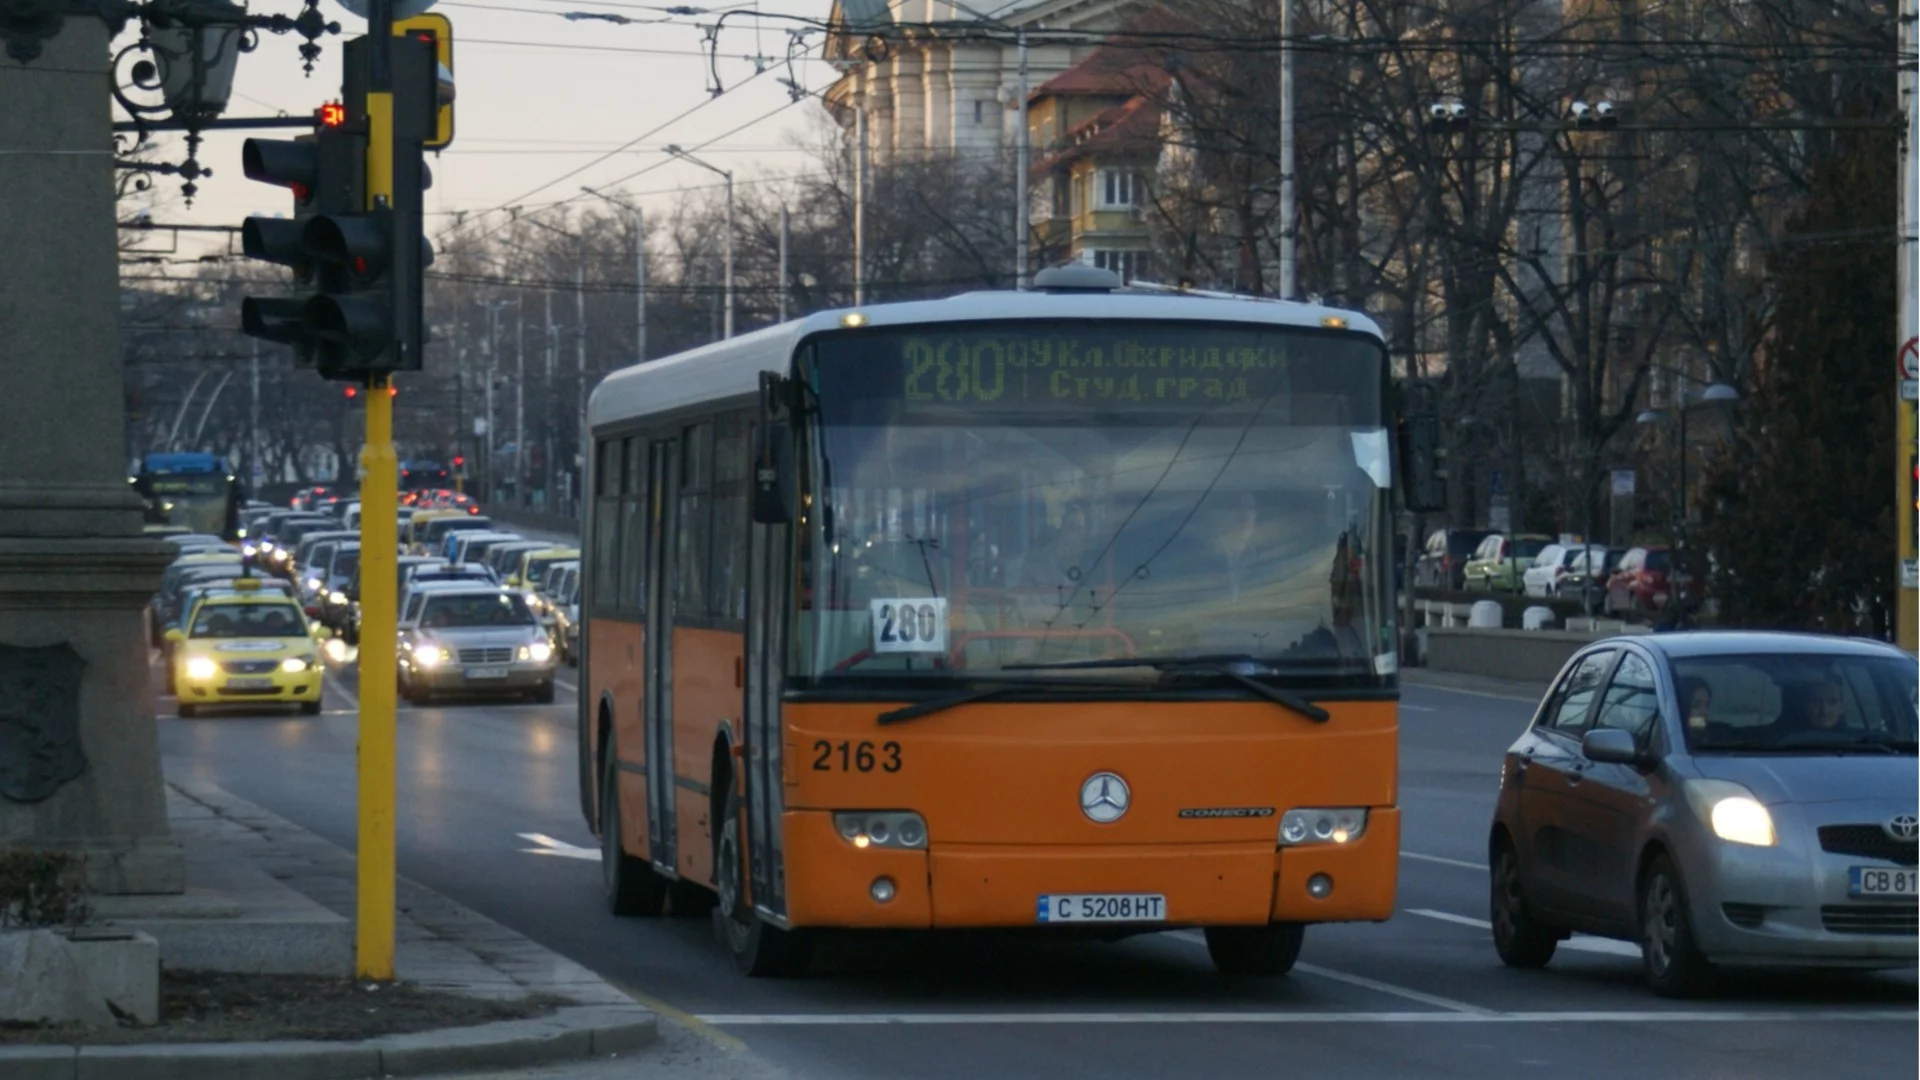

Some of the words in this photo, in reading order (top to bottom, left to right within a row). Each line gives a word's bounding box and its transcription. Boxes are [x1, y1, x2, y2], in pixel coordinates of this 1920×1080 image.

[905, 338, 1004, 400] 280
[880, 604, 936, 643] 280
[813, 740, 902, 773] 2163
[1180, 807, 1274, 817] CONECTO
